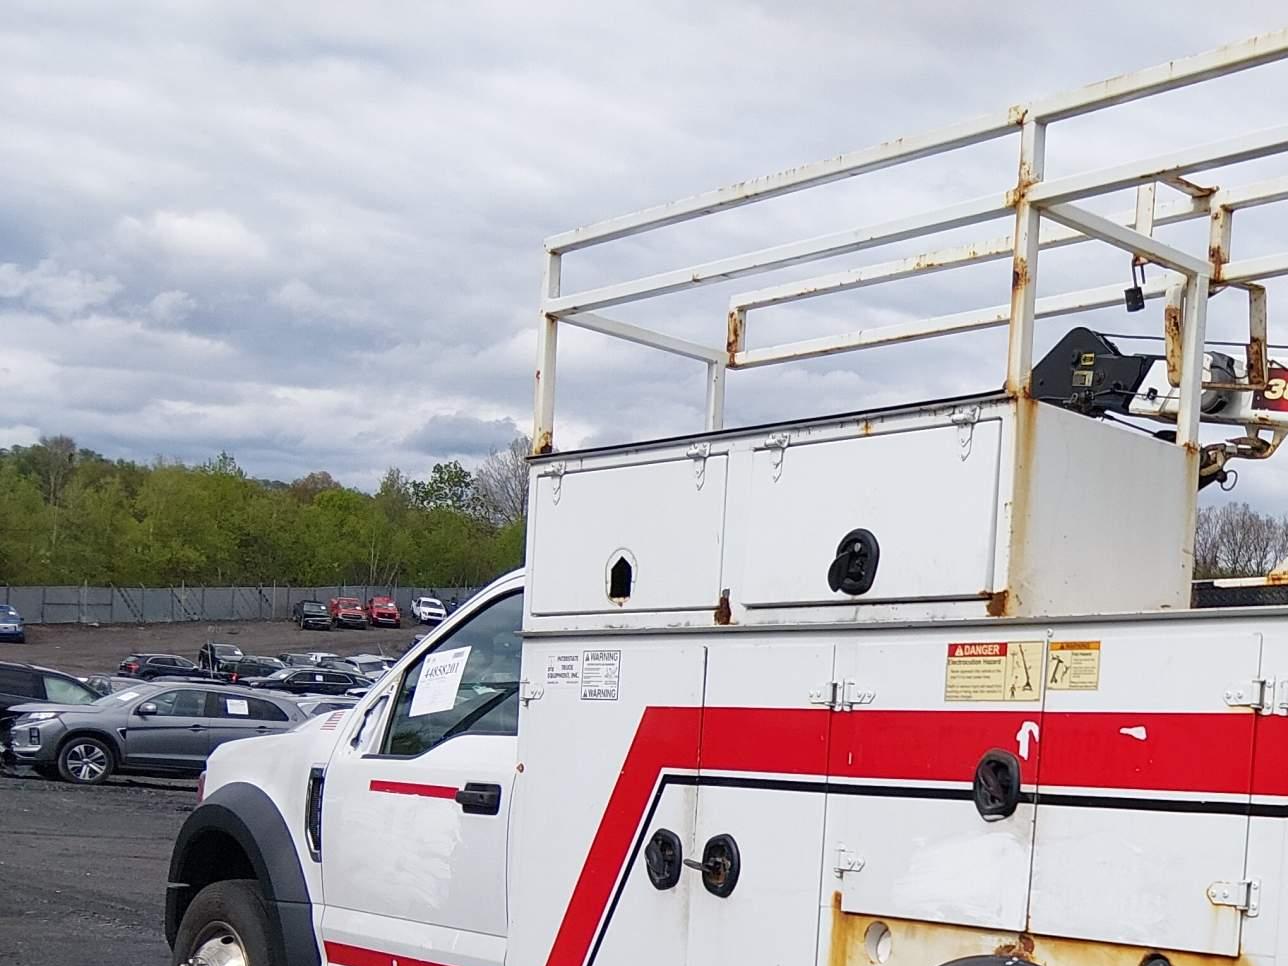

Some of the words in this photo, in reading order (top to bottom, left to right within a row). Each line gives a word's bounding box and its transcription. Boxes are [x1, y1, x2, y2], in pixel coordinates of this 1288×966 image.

[964, 644, 1000, 655] DANGER
[590, 652, 618, 662] WARNING
[588, 688, 616, 698] WARNING
